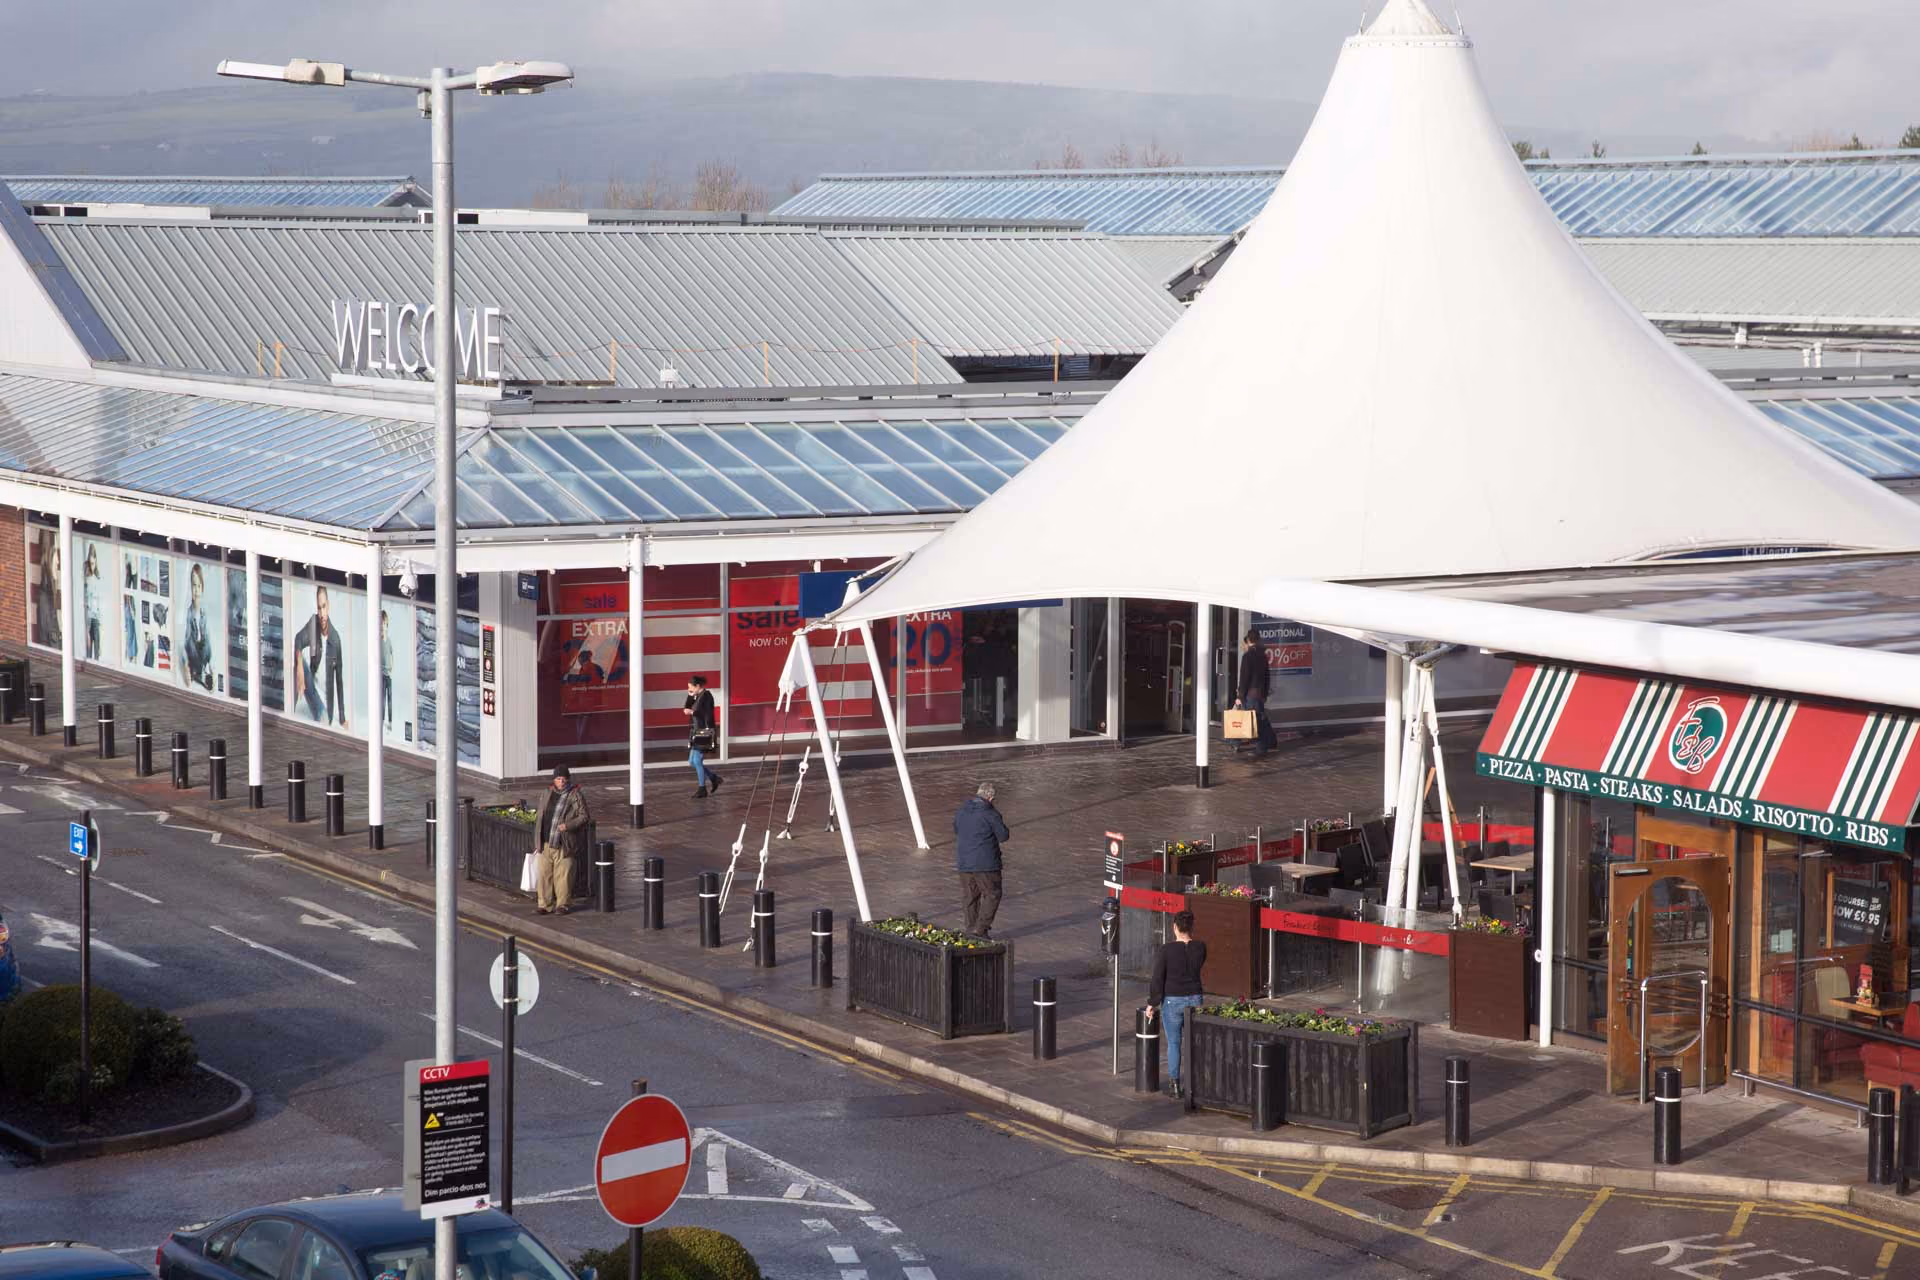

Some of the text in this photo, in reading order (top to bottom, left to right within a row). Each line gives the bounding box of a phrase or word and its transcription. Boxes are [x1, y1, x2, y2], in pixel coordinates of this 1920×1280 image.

[583, 592, 617, 609] sale
[736, 601, 799, 630] sale
[572, 620, 628, 637] EXTRA
[749, 636, 788, 647] NOW ON
[1489, 758, 1889, 846] PIZZA PASTA STEAKS SALADS RISOTTO RIBS
[1854, 909, 1880, 926] £9.95
[423, 1066, 450, 1080] CCTV
